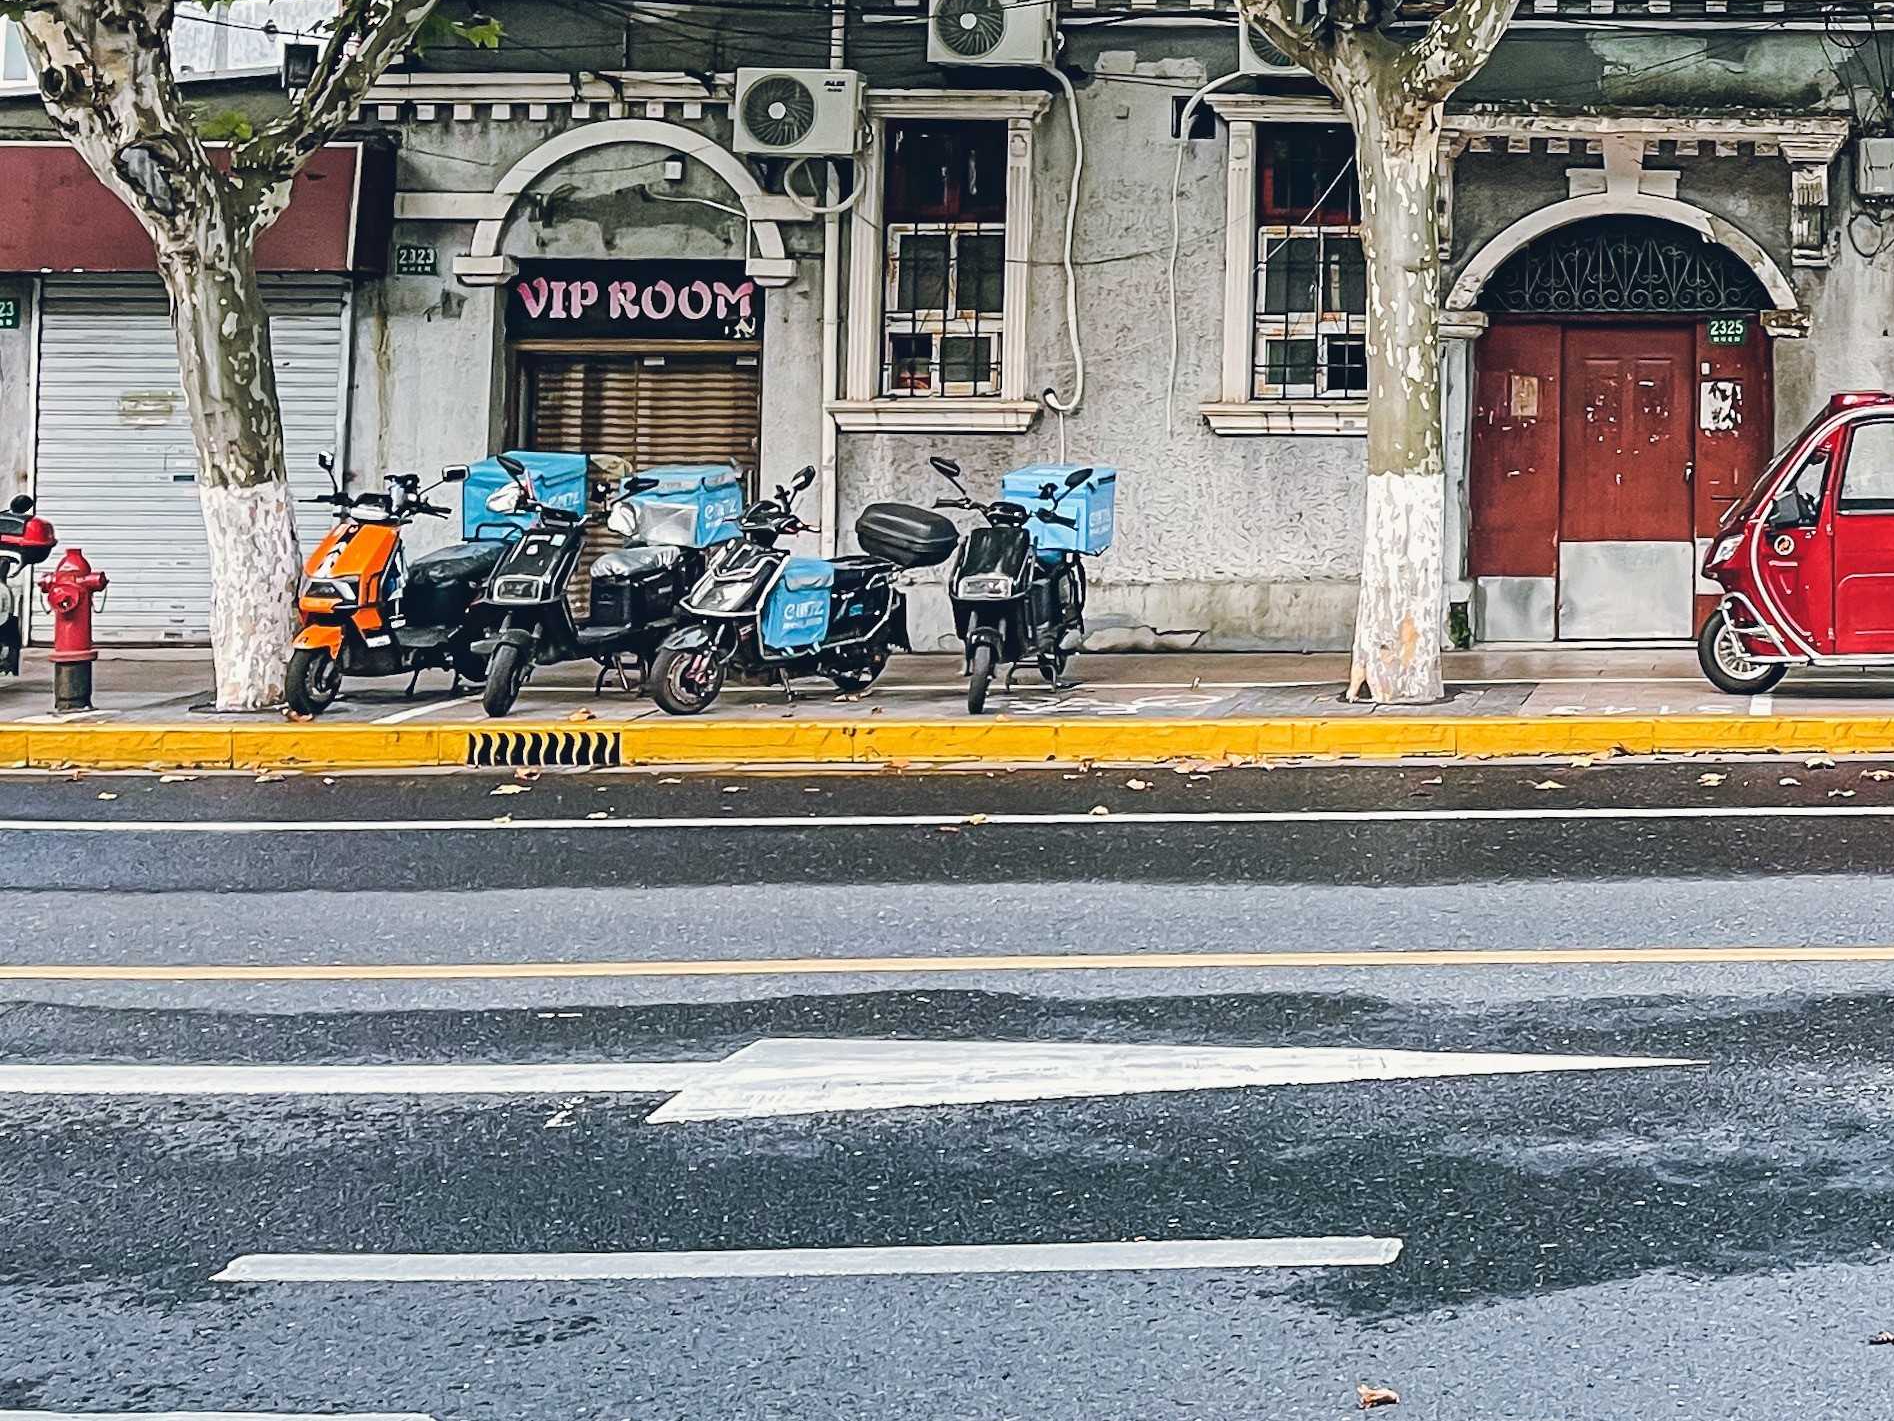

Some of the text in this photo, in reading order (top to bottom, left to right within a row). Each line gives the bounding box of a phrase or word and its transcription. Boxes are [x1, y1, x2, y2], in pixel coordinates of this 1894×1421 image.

[517, 277, 754, 319] VIP ROOM
[1710, 320, 1744, 335] 2325
